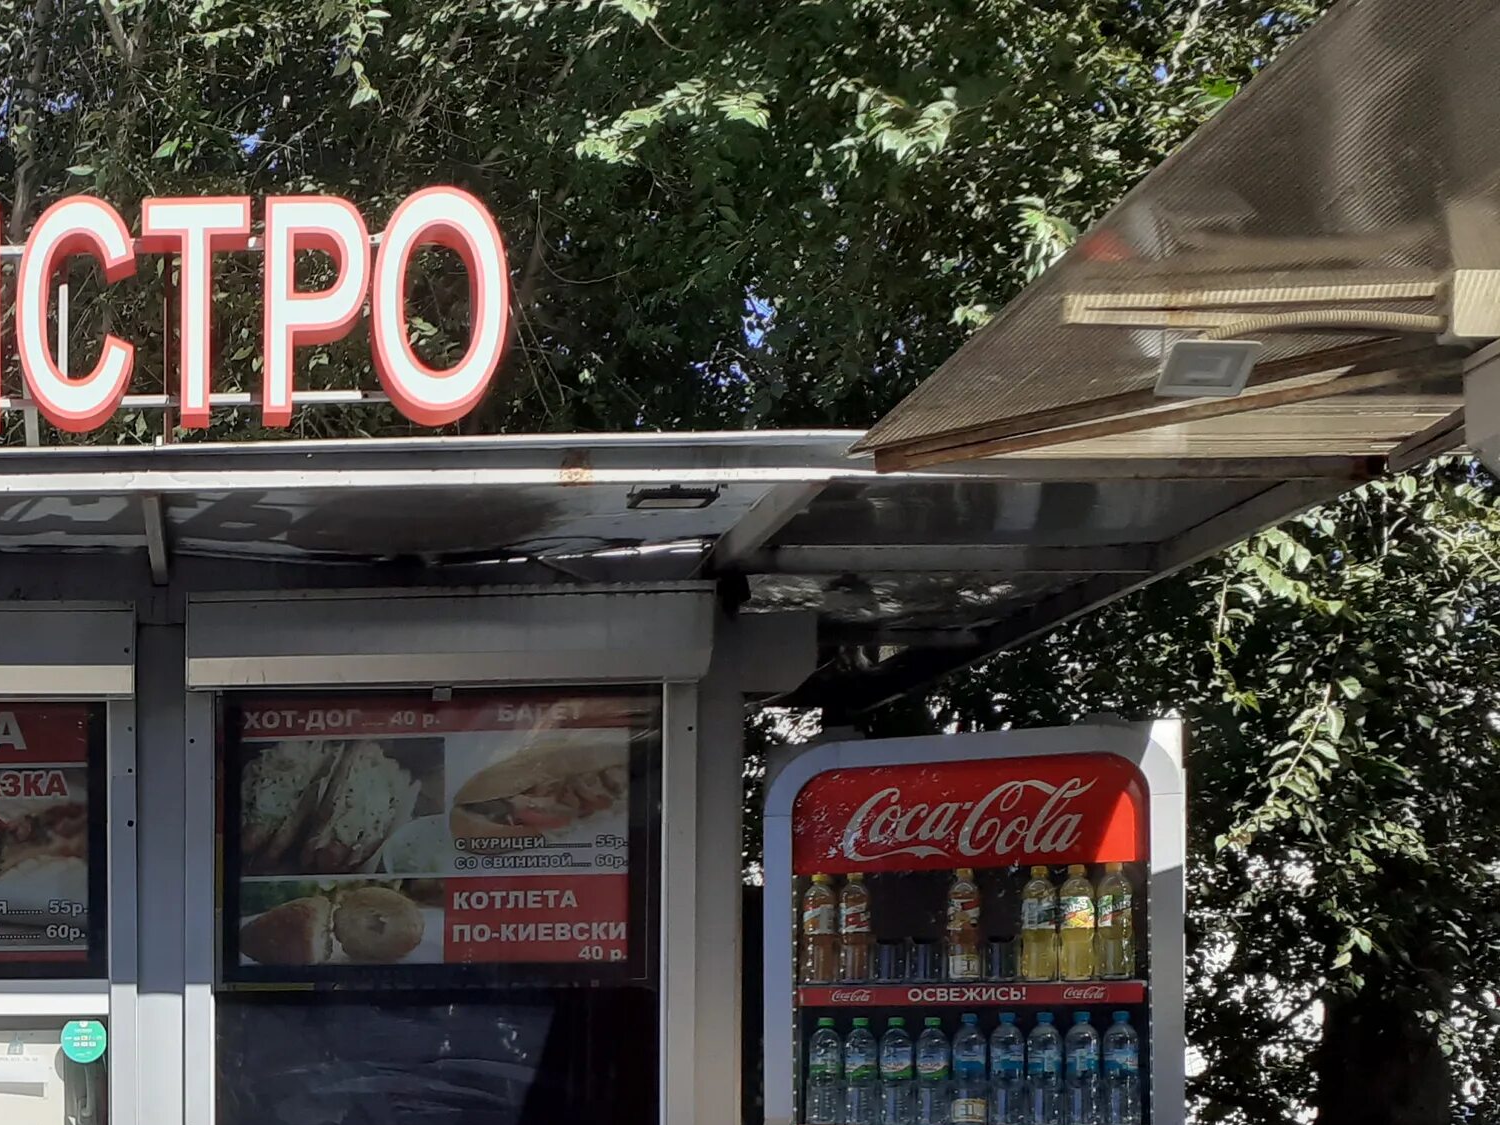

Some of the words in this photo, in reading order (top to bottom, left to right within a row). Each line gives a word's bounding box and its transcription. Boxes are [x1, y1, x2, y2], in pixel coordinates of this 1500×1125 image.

[243, 710, 362, 731] ХОТ-ДОГ
[391, 711, 414, 726] 40
[841, 776, 1099, 862] Coca-Cola
[455, 837, 467, 850] С
[471, 834, 546, 851] КУРИЦЕЙ
[455, 857, 478, 869] СО
[482, 853, 574, 869] СВИНИНОЙ
[453, 889, 579, 911] КОТЛЕТА
[452, 922, 628, 943] ПО-КИЕВСКИ
[578, 946, 603, 961] 40
[908, 986, 1027, 1002] ОСВЕЖИСЬ!
